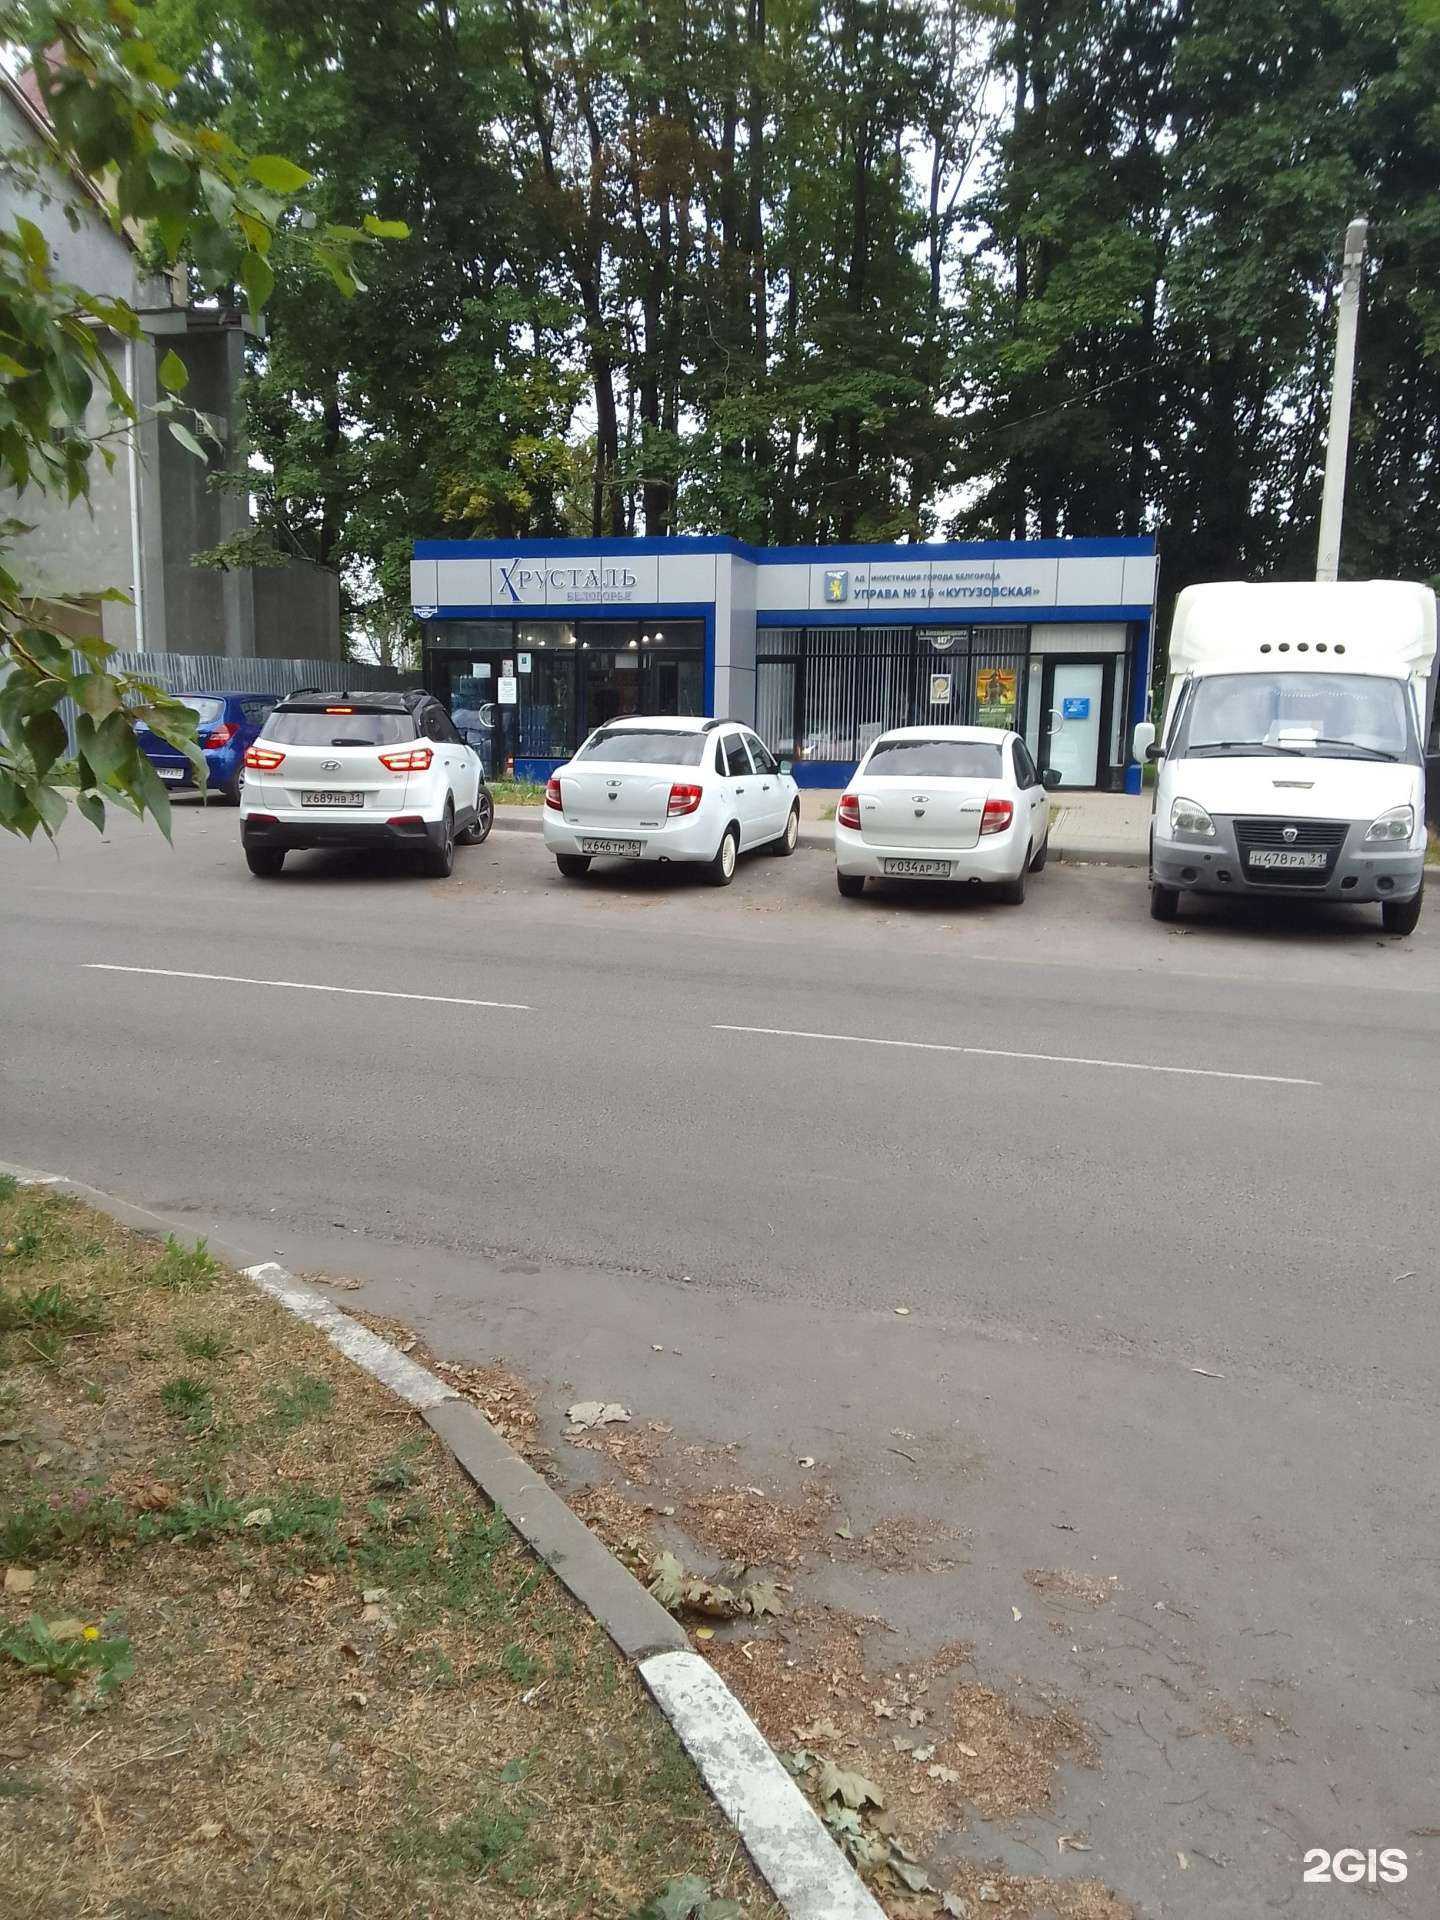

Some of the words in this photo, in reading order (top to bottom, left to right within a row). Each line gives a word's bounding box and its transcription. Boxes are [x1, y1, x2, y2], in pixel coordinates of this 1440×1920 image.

[499, 558, 637, 603] ХРУСТАЛЬ
[854, 573, 921, 583] АДИНИСТРАЦИЯ
[923, 573, 954, 582] ГОРОДА
[854, 588, 899, 599] УПРАВА
[903, 587, 917, 599] №
[920, 587, 935, 599] 16
[938, 585, 1040, 598] «КУТУЗОВСКАЯ»
